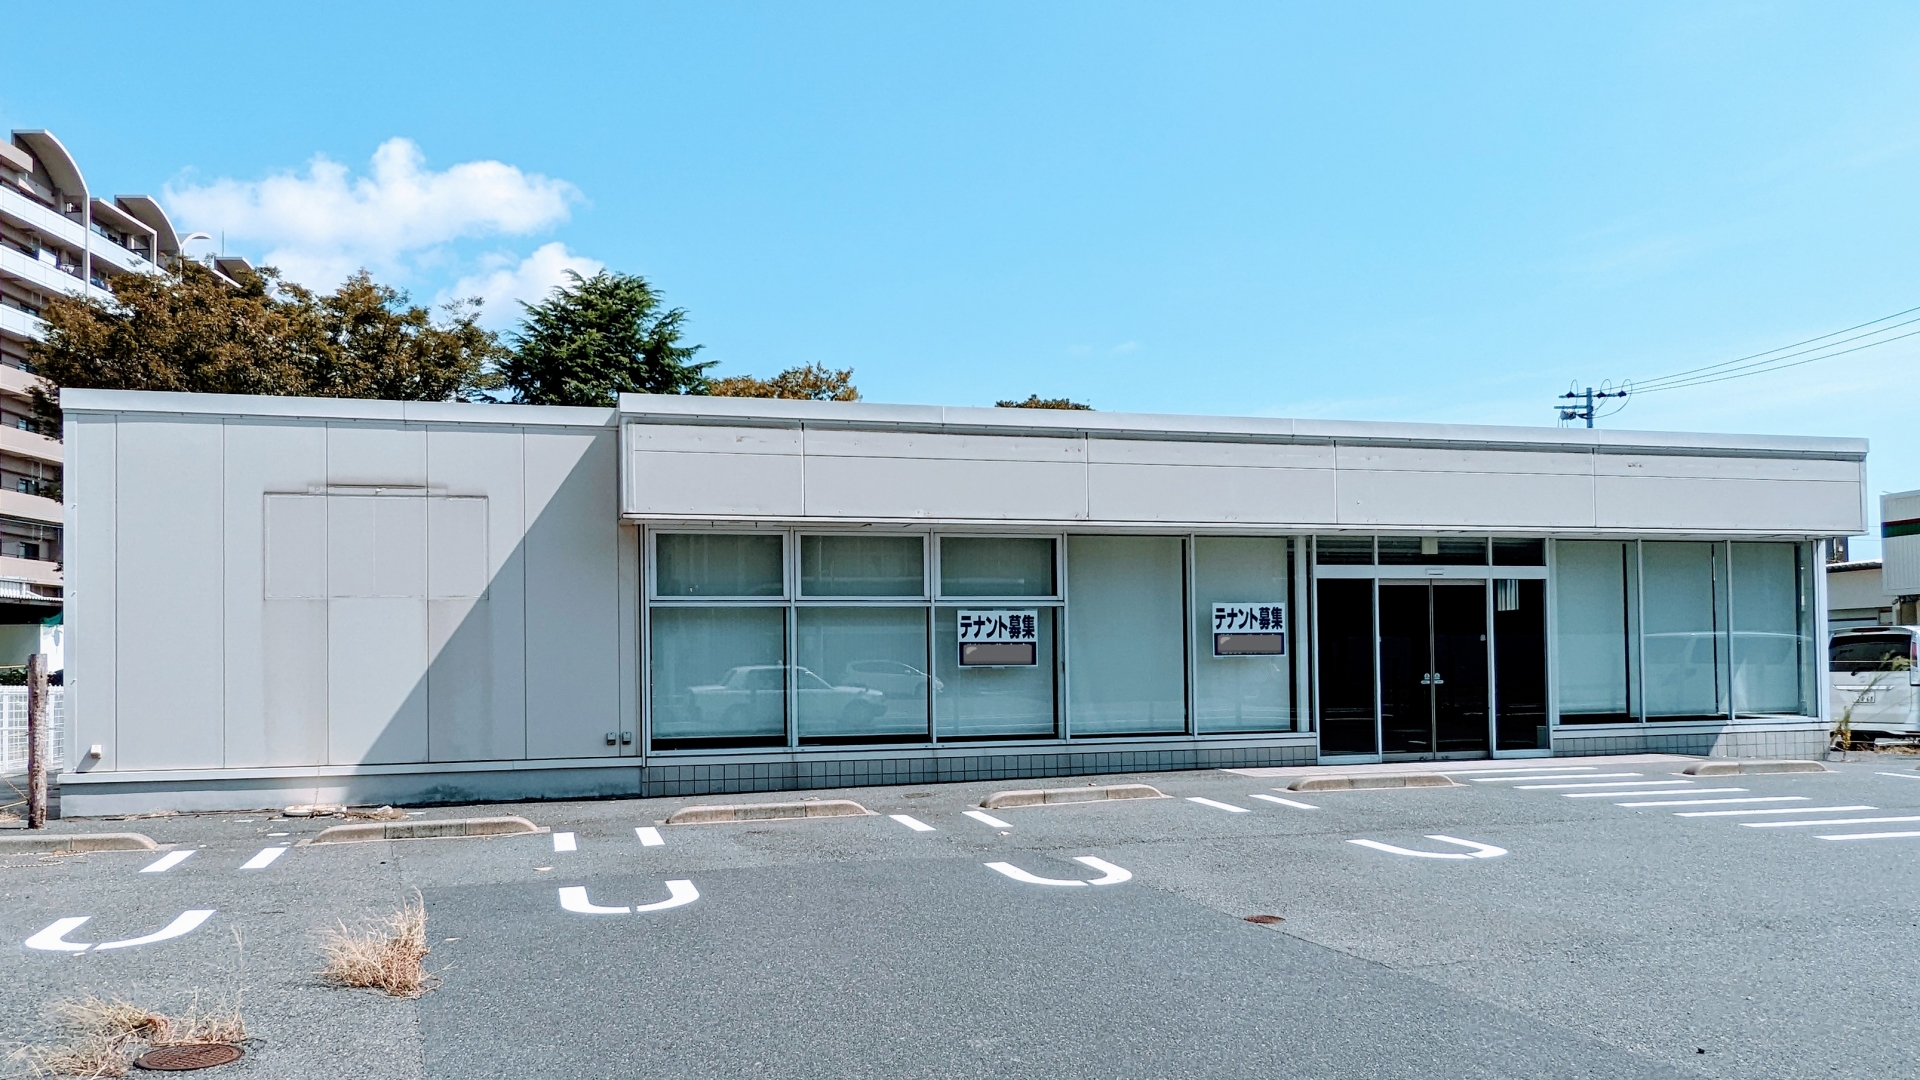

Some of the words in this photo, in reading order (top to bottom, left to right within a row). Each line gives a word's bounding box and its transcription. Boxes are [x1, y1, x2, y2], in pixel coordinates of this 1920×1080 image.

[960, 614, 1035, 639] テナント募集
[1215, 606, 1283, 630] テナント募集
